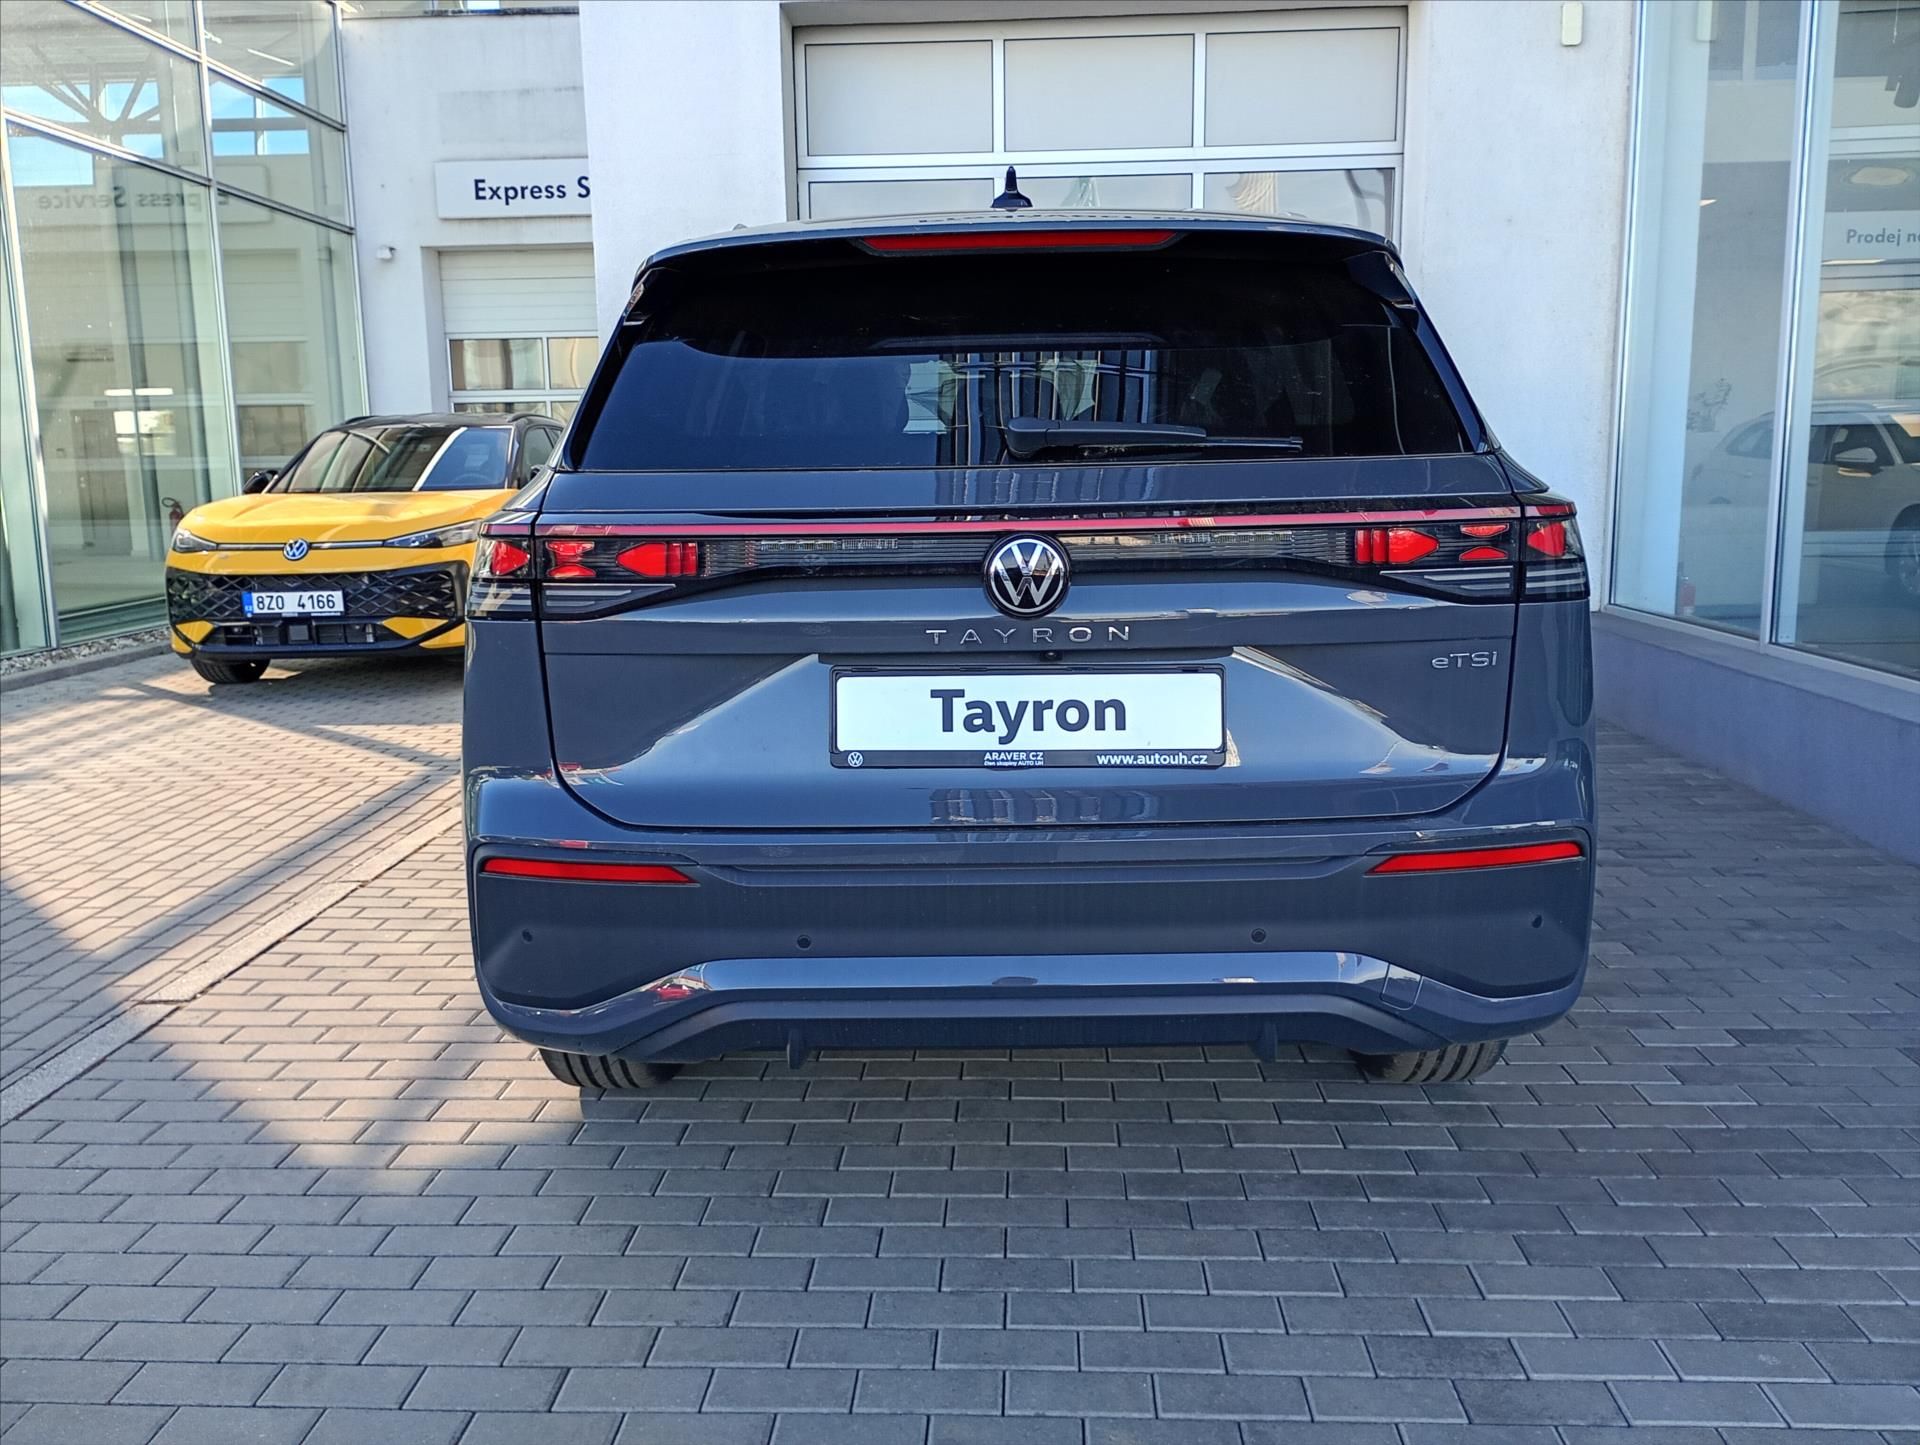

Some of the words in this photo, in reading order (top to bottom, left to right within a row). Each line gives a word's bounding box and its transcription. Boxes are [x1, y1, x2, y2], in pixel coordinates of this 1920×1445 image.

[473, 178, 567, 206] Express
[1846, 227, 1902, 247] Prodej
[297, 594, 336, 610] 4166
[925, 625, 1130, 645] TAYRON
[930, 688, 1127, 745] Tayron
[984, 751, 1027, 761] ARAVER
[1029, 751, 1044, 761] CZ
[1096, 752, 1208, 765] www.autouh.cz
